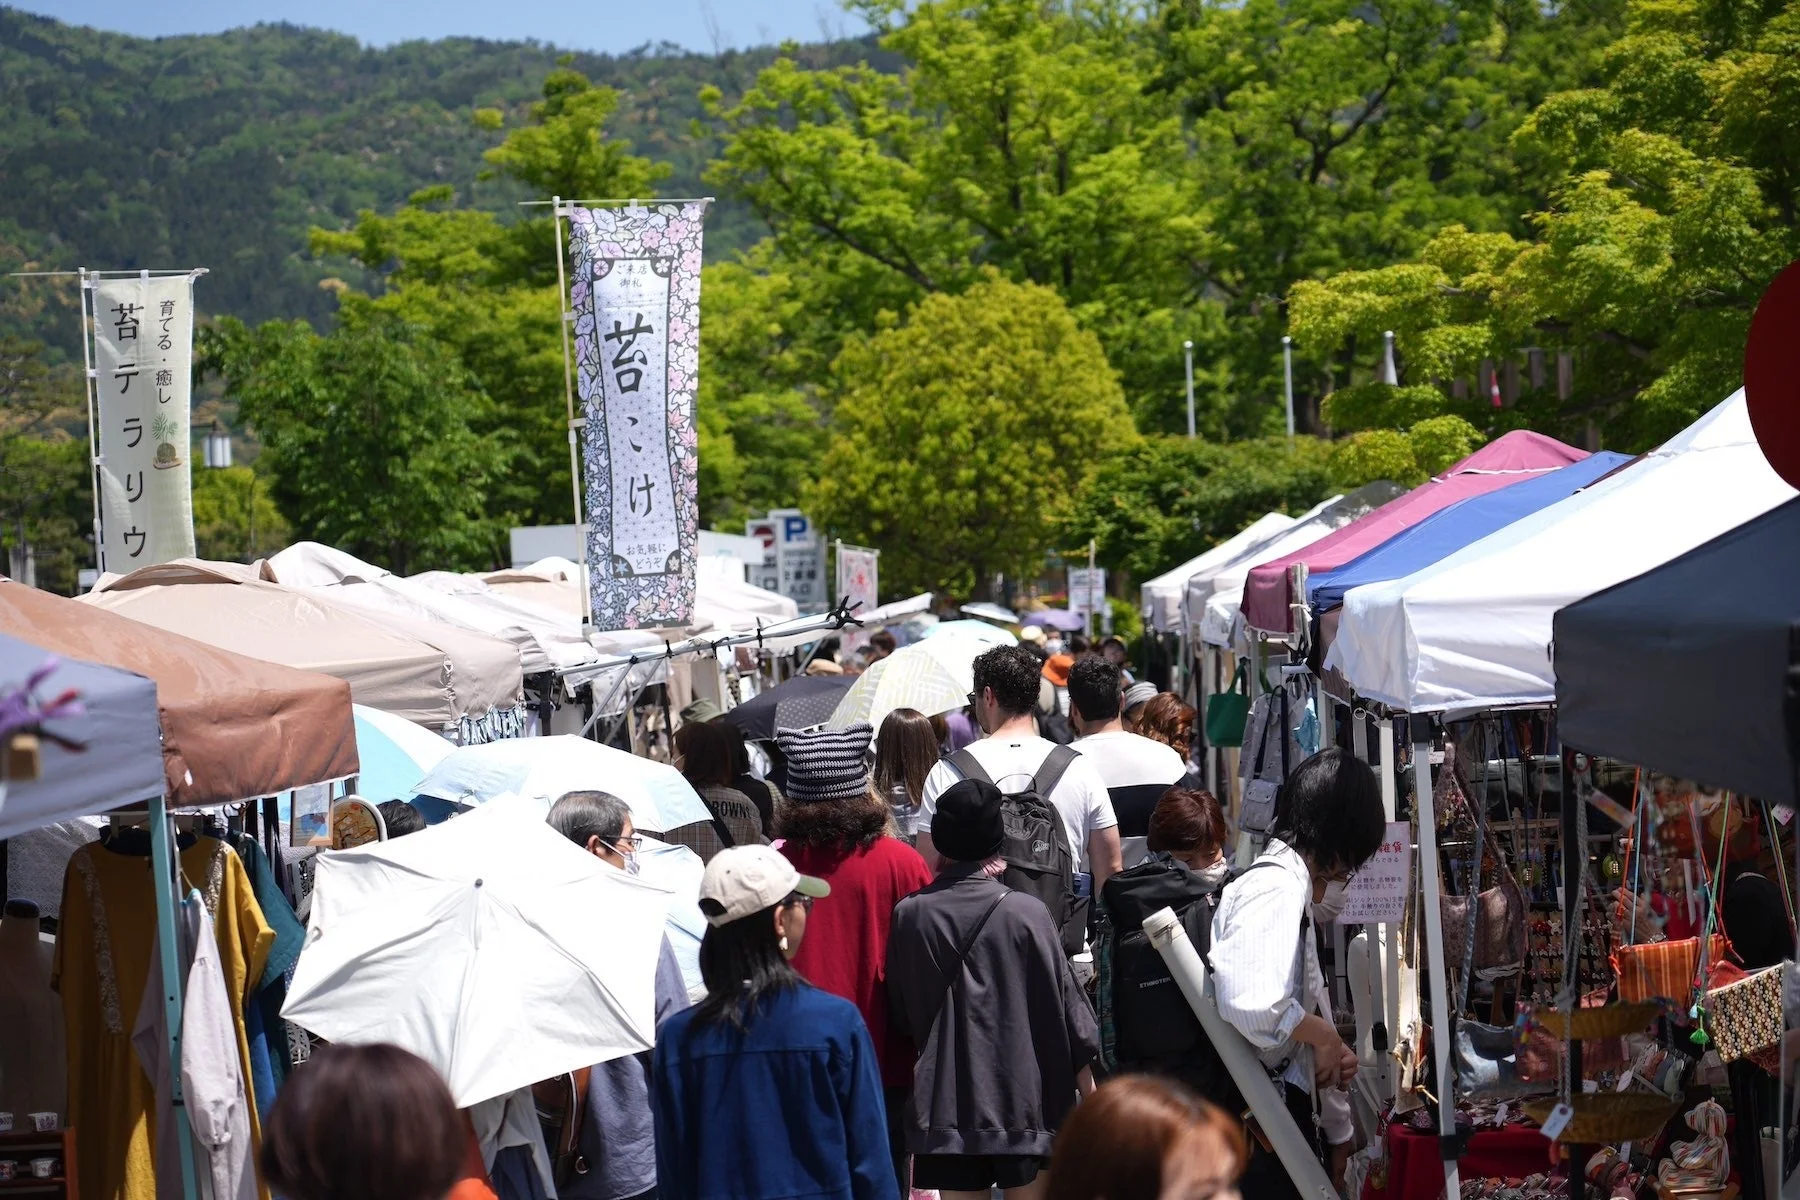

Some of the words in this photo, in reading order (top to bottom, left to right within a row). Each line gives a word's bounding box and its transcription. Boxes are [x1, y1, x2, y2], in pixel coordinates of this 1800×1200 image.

[616, 263, 648, 275] ご来店
[618, 278, 642, 288] 御礼
[156, 300, 176, 404] 育てる・癒し
[785, 516, 807, 541] P
[626, 543, 667, 556] お気軽に
[635, 557, 663, 570] どうぞ
